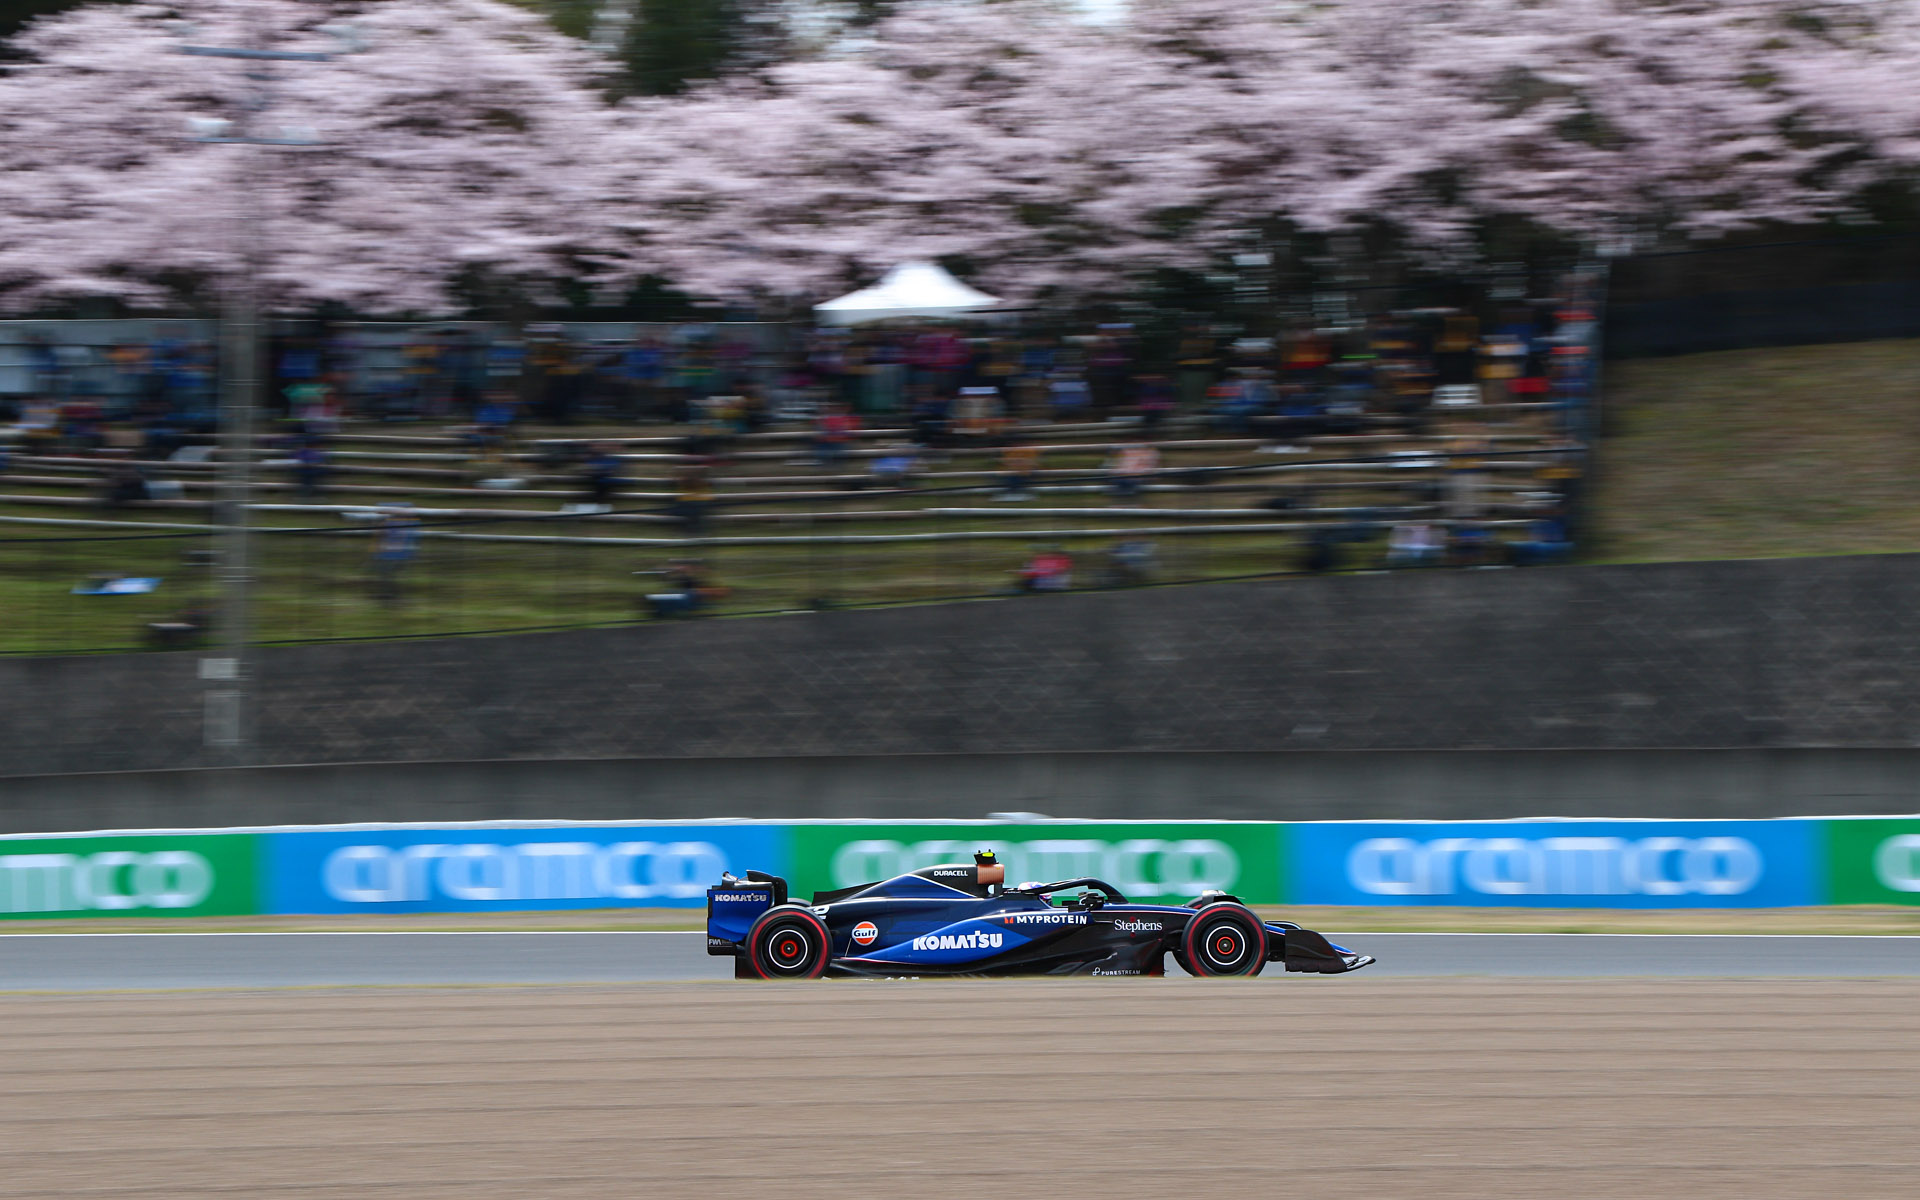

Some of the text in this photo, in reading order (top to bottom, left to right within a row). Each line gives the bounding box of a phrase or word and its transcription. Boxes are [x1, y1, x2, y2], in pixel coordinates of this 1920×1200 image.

[322, 842, 728, 902] aramco
[1347, 836, 1762, 895] aramco
[714, 893, 767, 902] KOMATSU
[1016, 915, 1088, 925] MYPROTEIN
[1114, 919, 1163, 933] Stephens
[913, 930, 1003, 951] KOMATSU
